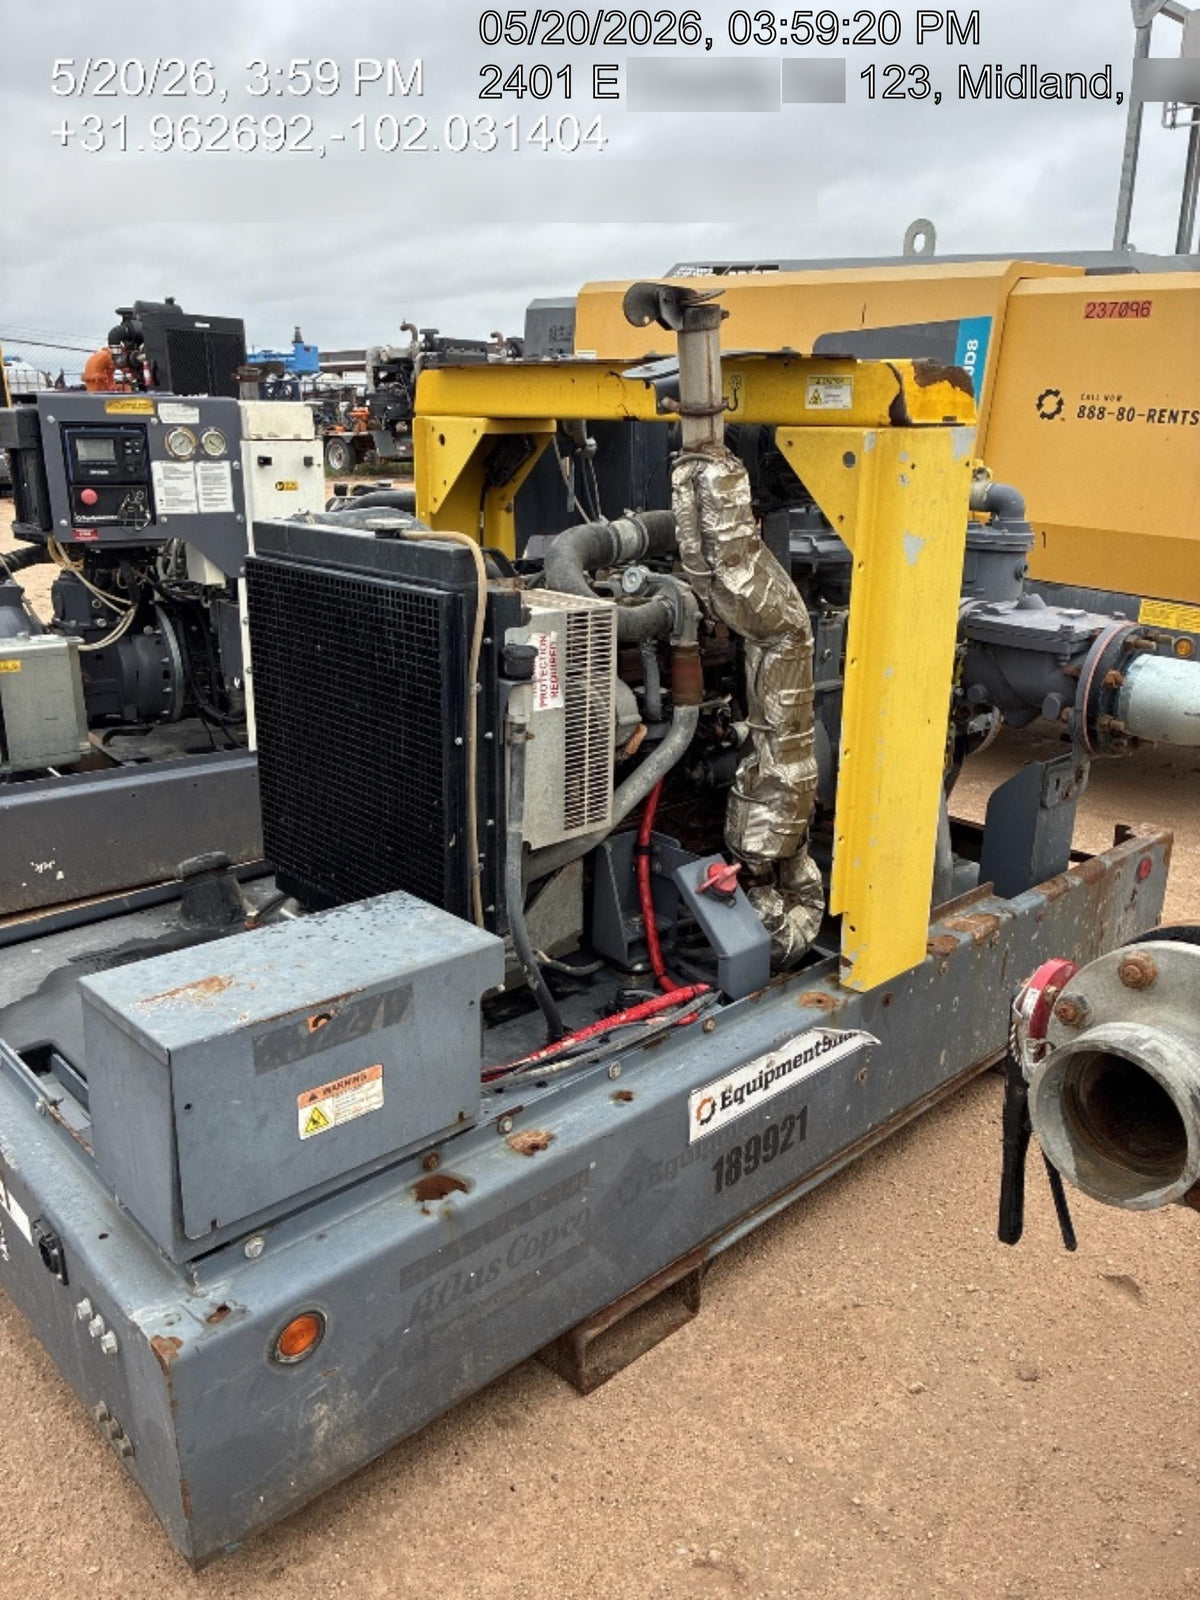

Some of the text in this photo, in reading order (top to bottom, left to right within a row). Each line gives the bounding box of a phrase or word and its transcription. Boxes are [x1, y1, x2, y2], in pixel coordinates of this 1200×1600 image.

[1077, 405, 1200, 426] 888-80-RENTS
[540, 635, 548, 708] PROTECTION
[550, 641, 558, 699] REQUIRED
[323, 1072, 367, 1095] WARNING
[712, 1106, 808, 1195] 189921
